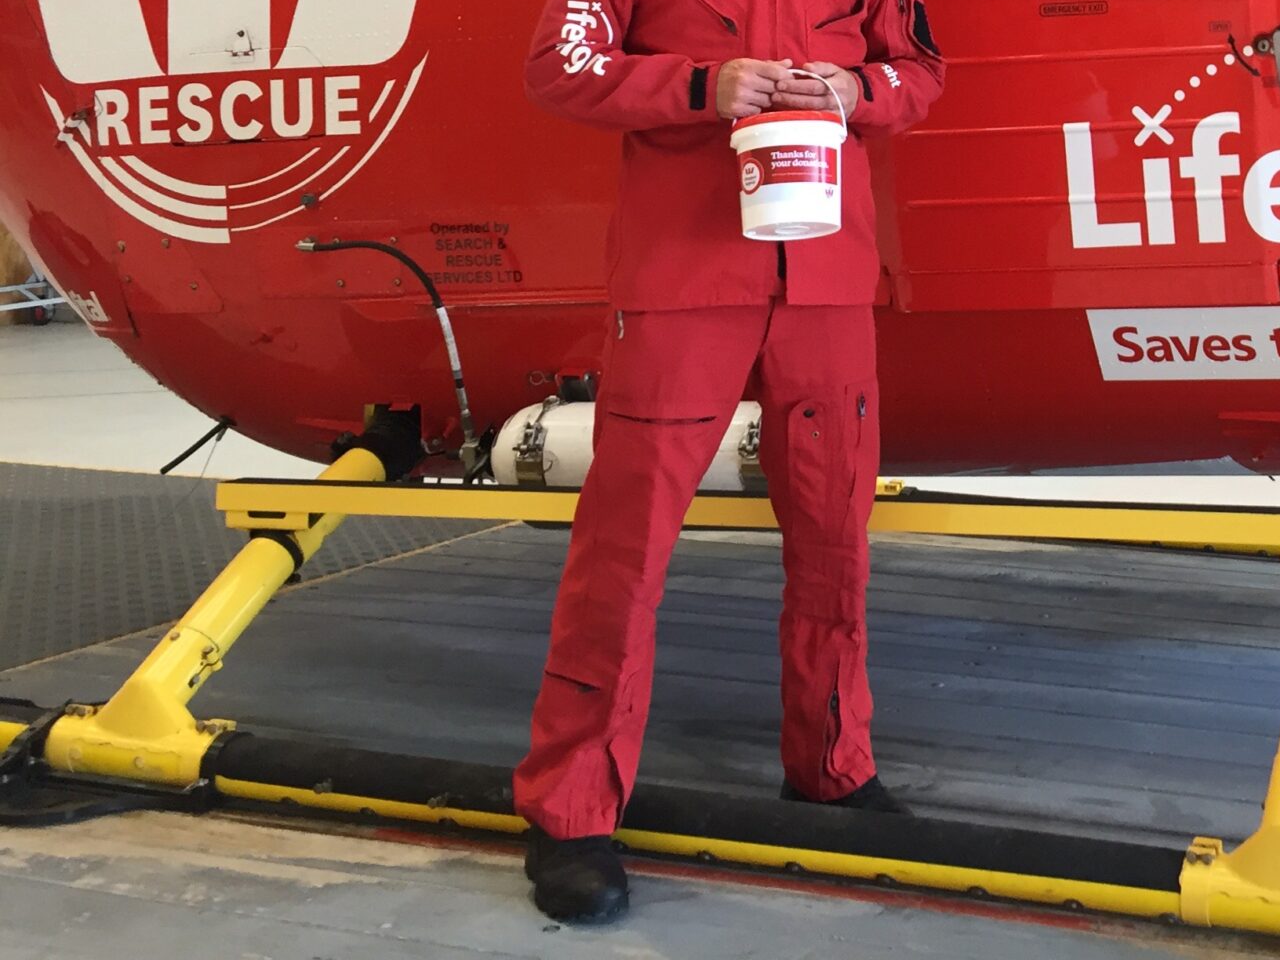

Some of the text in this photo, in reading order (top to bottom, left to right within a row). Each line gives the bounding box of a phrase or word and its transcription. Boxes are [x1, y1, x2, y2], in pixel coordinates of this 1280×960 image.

[95, 74, 362, 146] RESCUE
[770, 149, 817, 160] Thanks for
[770, 159, 792, 170] your
[430, 221, 510, 236] Operated by
[435, 236, 507, 252] SEARCH &
[446, 254, 503, 268] RESCUE
[497, 270, 523, 283] LTD
[1112, 326, 1256, 363] Saves
